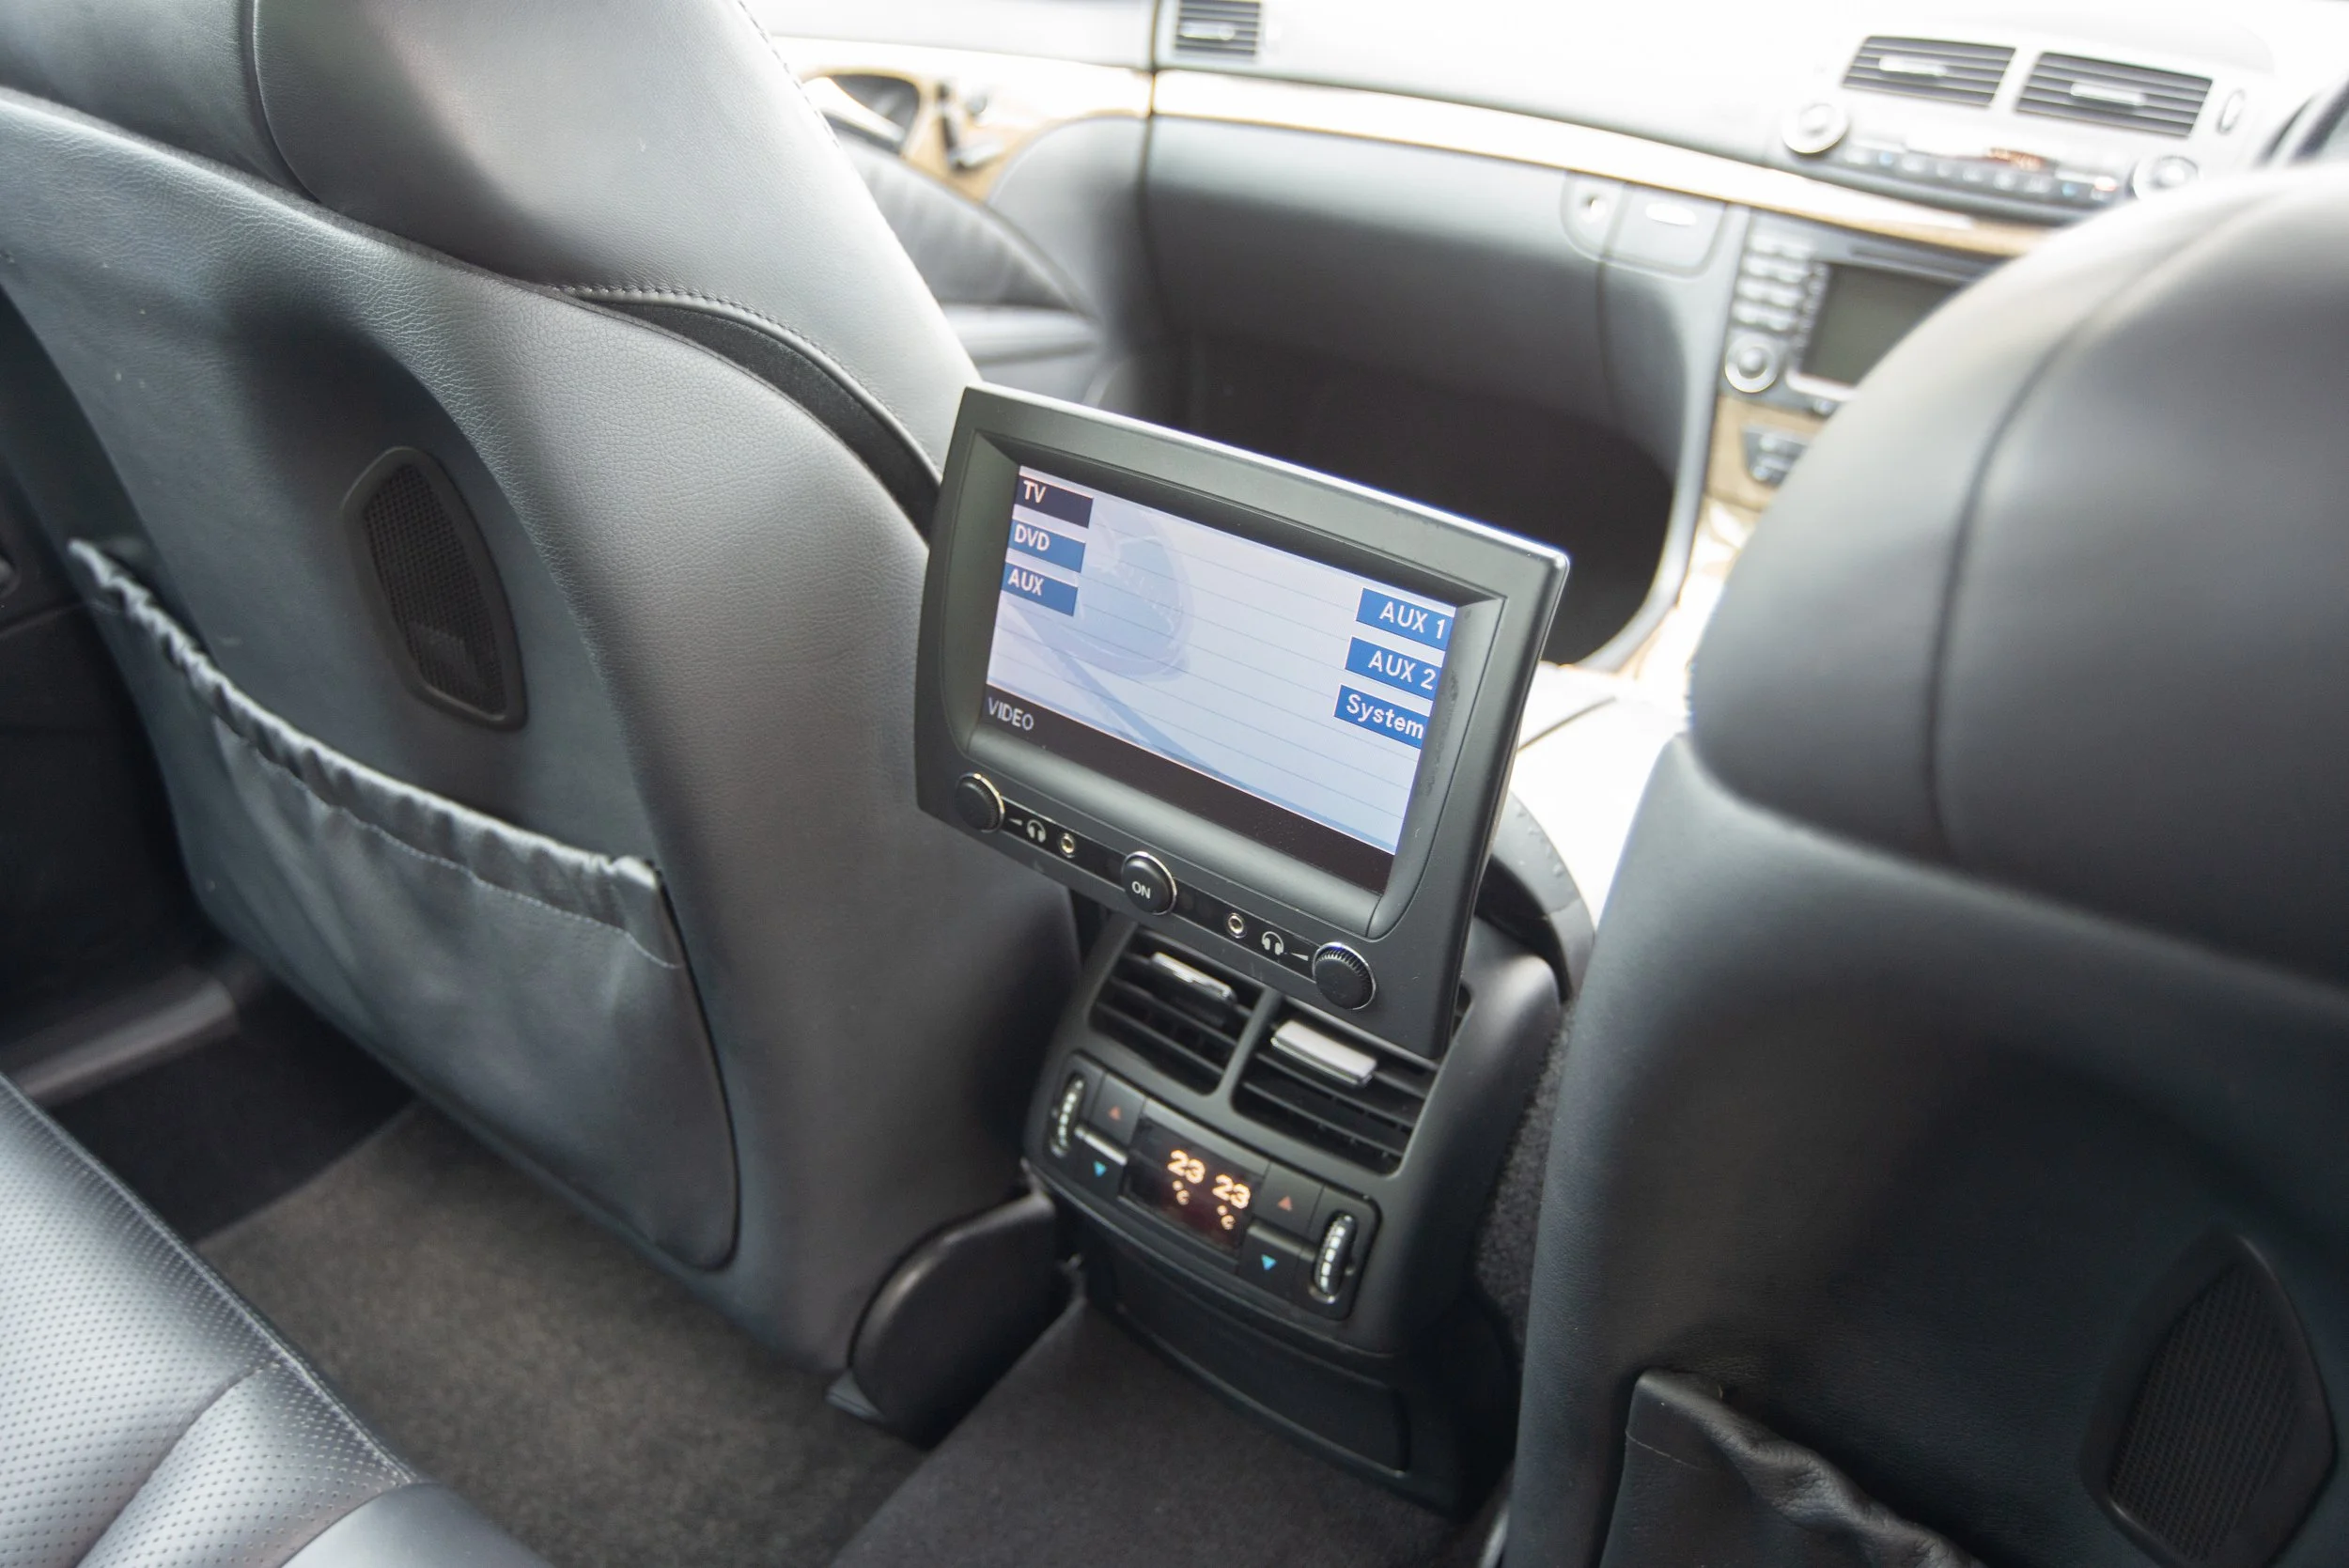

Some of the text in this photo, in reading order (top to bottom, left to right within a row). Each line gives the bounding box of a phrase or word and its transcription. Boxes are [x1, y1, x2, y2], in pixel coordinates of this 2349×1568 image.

[1023, 480, 1047, 504] TV
[1014, 523, 1050, 551] DVD
[1007, 568, 1045, 597] AUX
[1378, 601, 1446, 640] AUX 1
[1368, 650, 1437, 691] AUX 2
[988, 697, 1034, 731] VIDEO
[1346, 693, 1424, 739] System
[1131, 881, 1151, 899] ON
[1167, 1149, 1252, 1209] 23 23
